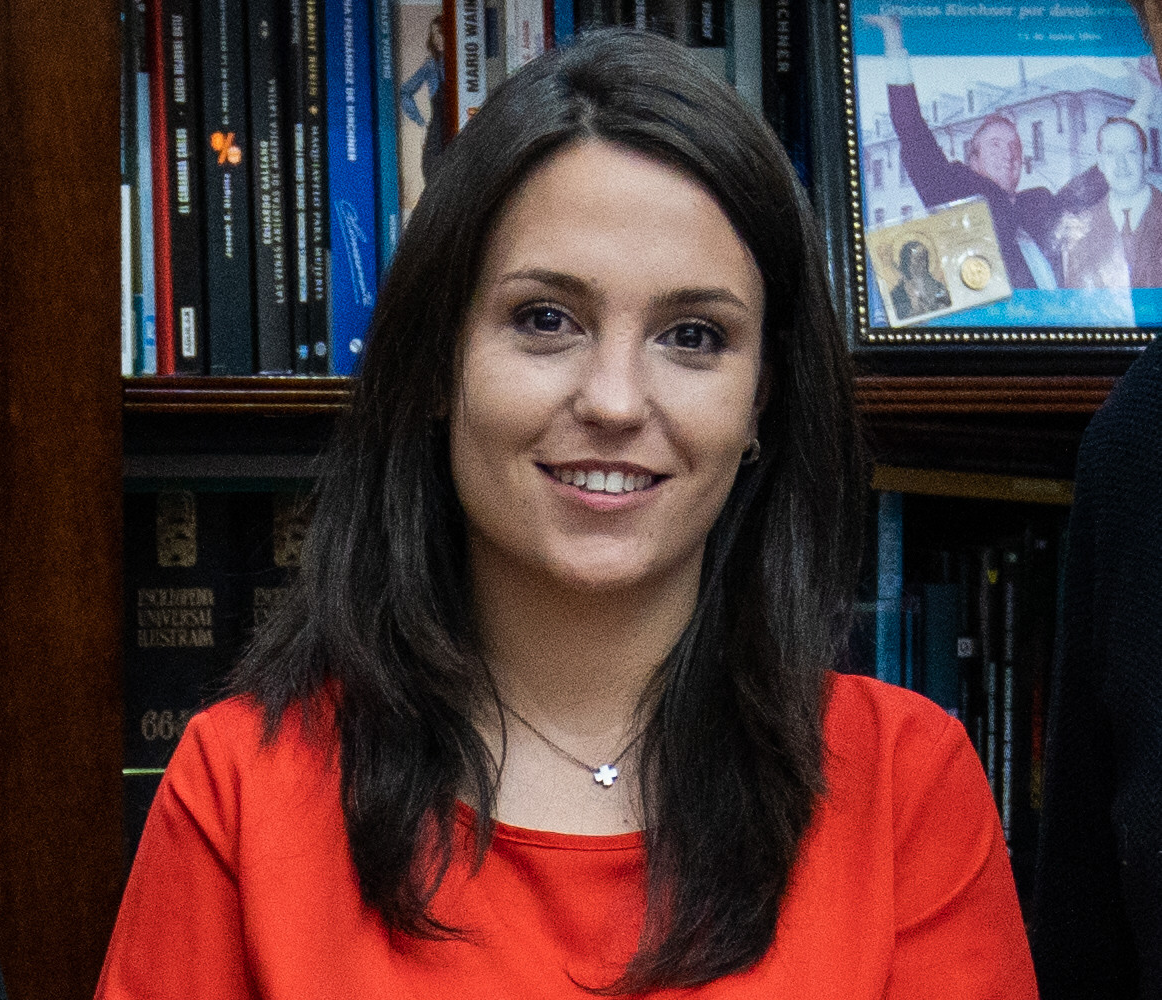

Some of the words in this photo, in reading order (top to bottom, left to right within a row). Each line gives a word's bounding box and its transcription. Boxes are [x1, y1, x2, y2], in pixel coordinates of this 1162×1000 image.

[464, 42, 479, 93] MARIO
[345, 87, 356, 103] DE
[259, 141, 270, 190] GALEANO
[271, 173, 281, 187] DE
[273, 246, 284, 281] VENAS
[275, 284, 285, 304] LAS
